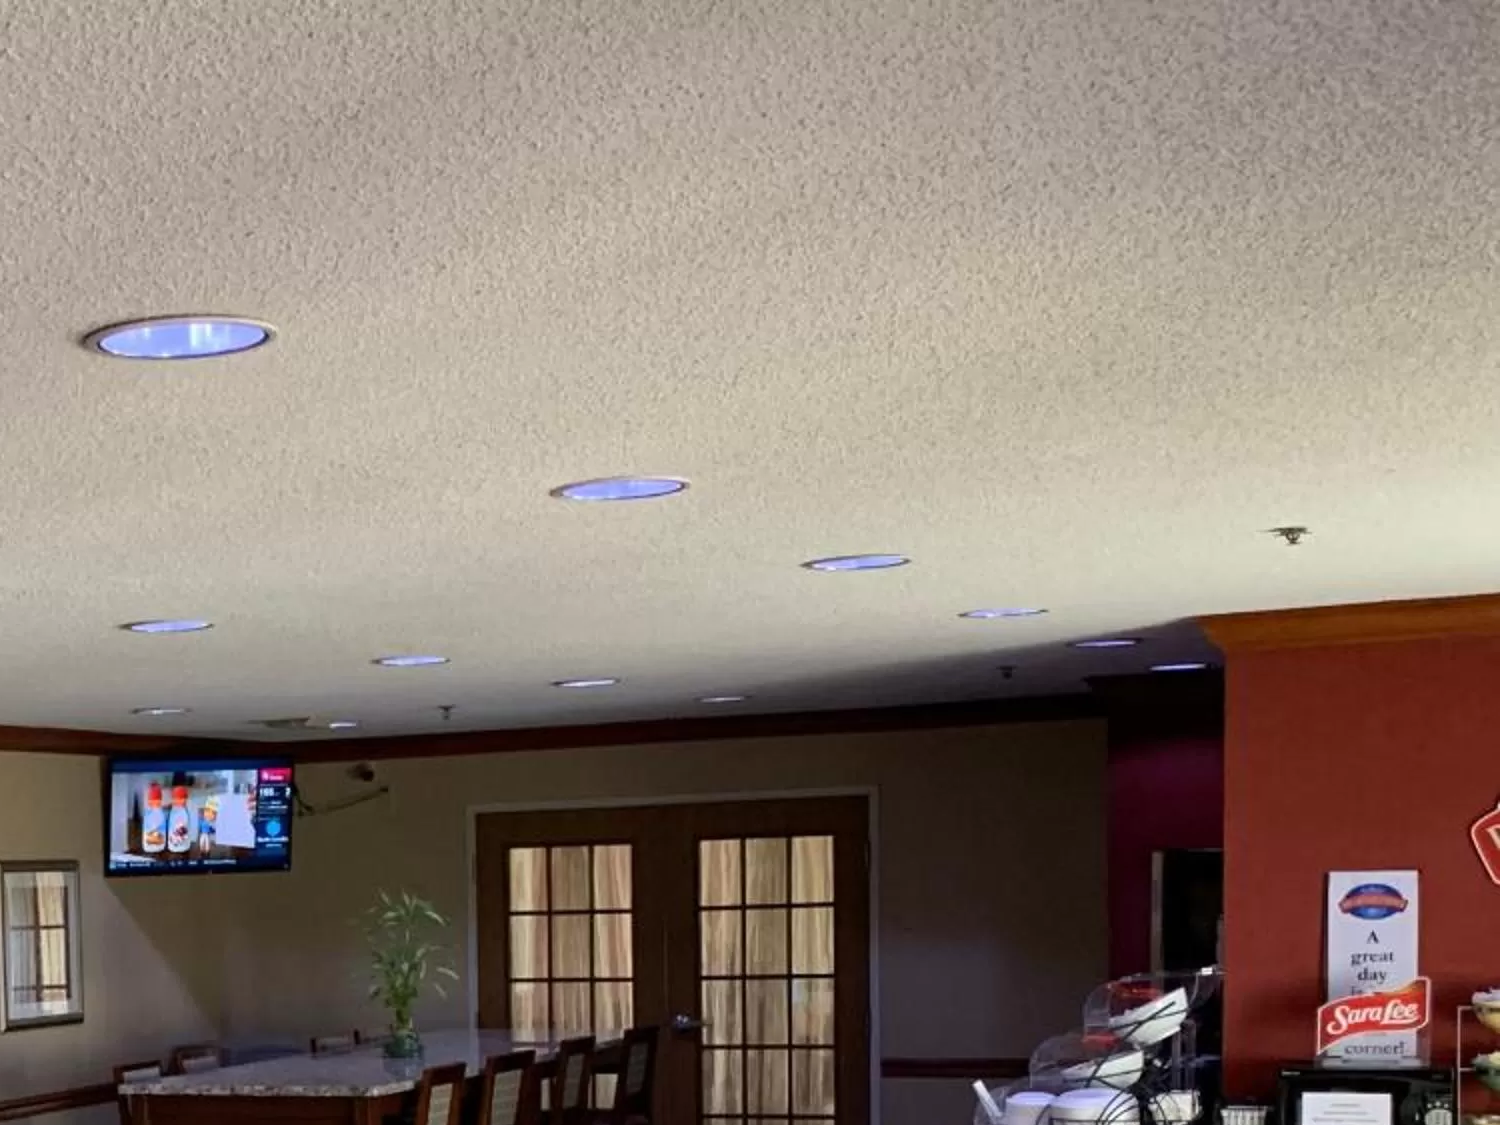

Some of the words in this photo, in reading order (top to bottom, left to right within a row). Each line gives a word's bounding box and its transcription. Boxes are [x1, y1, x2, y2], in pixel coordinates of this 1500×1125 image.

[1366, 929, 1380, 944] A
[1350, 951, 1394, 967] great
[1357, 967, 1387, 985] day
[1326, 1004, 1382, 1035] Sara
[1380, 999, 1421, 1025] Lee
[1343, 1041, 1406, 1056] corner!
